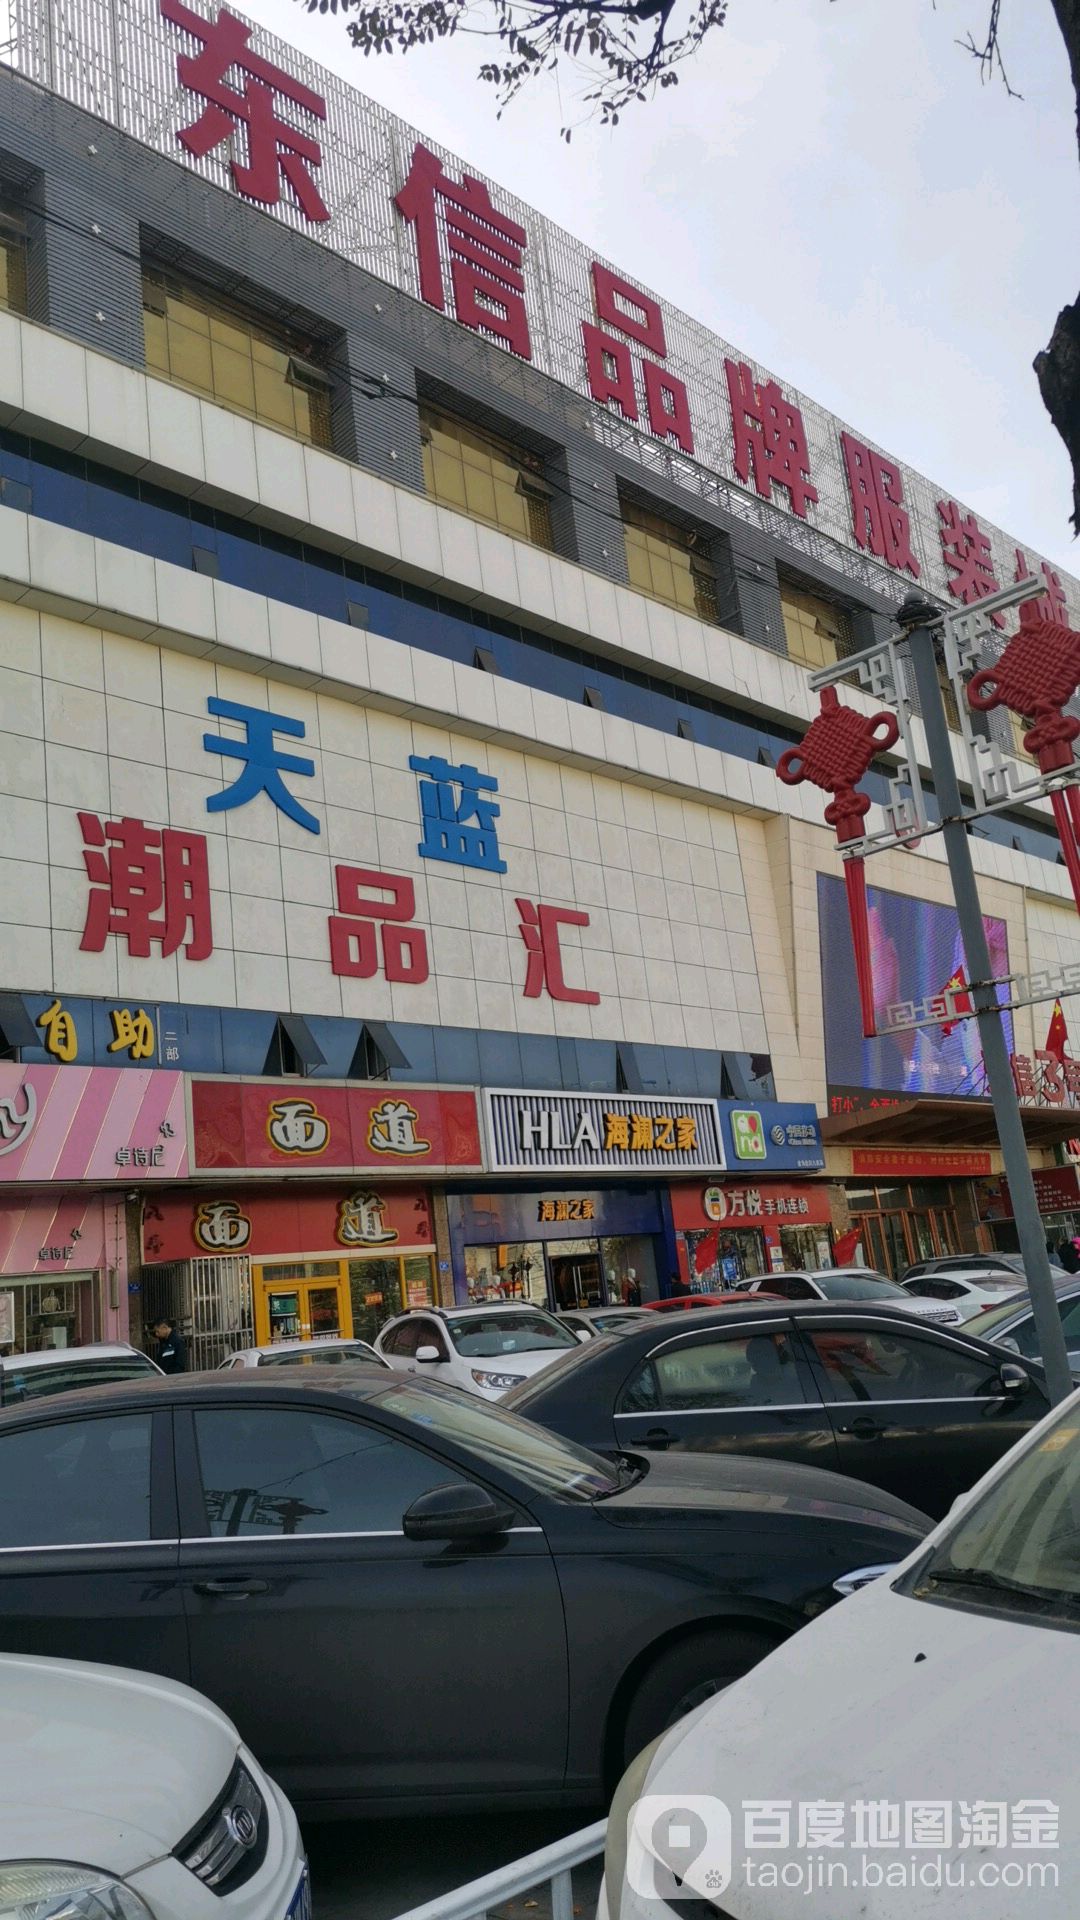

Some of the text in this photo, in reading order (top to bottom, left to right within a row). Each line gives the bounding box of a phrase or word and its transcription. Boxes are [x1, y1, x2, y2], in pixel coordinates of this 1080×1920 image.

[203, 696, 507, 874] 天蓝
[77, 811, 600, 1005] 潮品汇
[268, 1098, 432, 1156] 面道
[520, 1110, 699, 1150] HLA 海澜之家
[197, 1191, 399, 1252] 面道
[538, 1200, 596, 1222] 海澜之家
